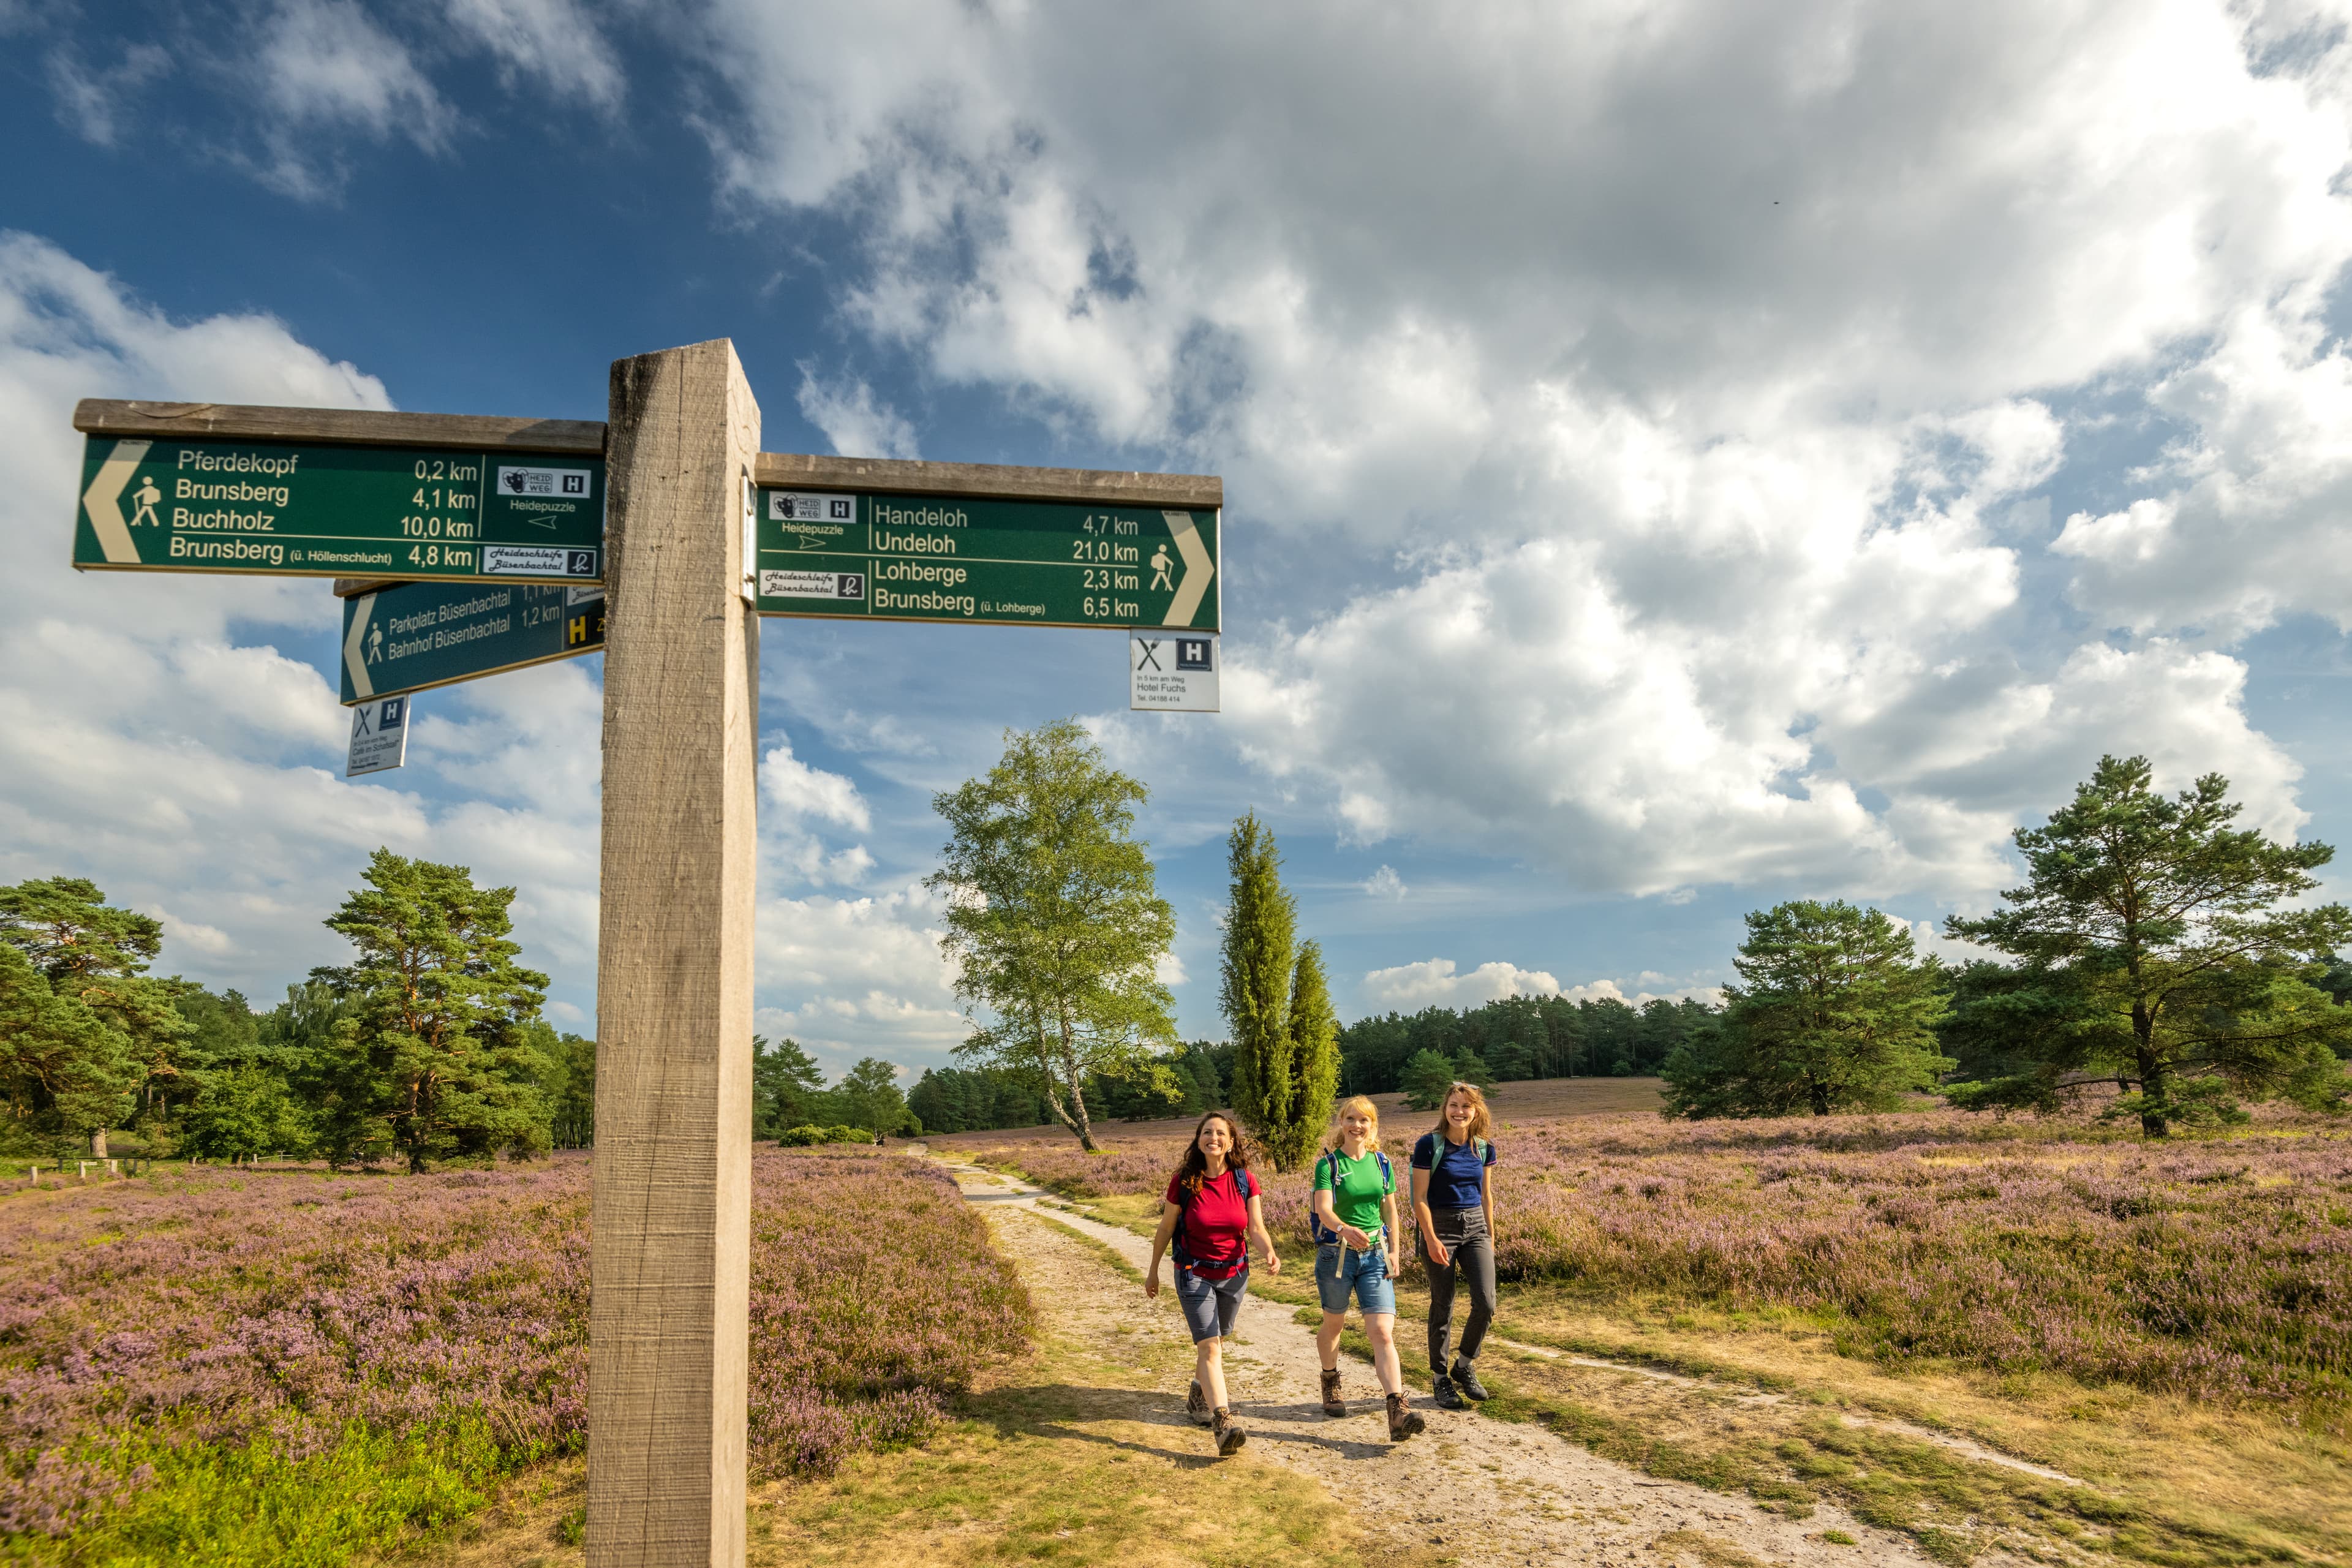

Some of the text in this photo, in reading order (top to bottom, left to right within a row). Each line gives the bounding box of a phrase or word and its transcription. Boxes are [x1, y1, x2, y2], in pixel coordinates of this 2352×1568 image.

[178, 450, 477, 482] Pferdekopf 0,2 km
[175, 478, 475, 510] Brunsberg 4,1 km
[510, 500, 576, 513] Heidepuzzle
[173, 508, 473, 539] Buchholz 10,0 km
[782, 522, 843, 536] Heidepuzzle
[876, 505, 1138, 537] Handeloh 4,7 km
[170, 537, 472, 568] Brunsberg (ü. Höllenschlucht) 4,8 km
[490, 548, 563, 561] Heideschleife
[876, 531, 1138, 562] Undeloh 21,0 km
[489, 560, 563, 571] Büsenbachtal
[766, 571, 833, 584] Heideschleife
[875, 560, 1138, 591] Lohberge 2,3 km
[765, 582, 834, 594] Büsenbachtal
[390, 610, 436, 635] Parkplatz
[439, 587, 511, 622] Büsenbachtal
[523, 585, 538, 602] 1,1
[875, 588, 1139, 619] Brunsberg (ü. Lohberge) 6,5 km
[389, 605, 559, 660] Bahnhof Büsenbachtal 1,2 km
[570, 616, 586, 644] H
[1186, 643, 1202, 661] H
[1137, 683, 1186, 692] Hotel Fuchs
[386, 703, 398, 720] H
